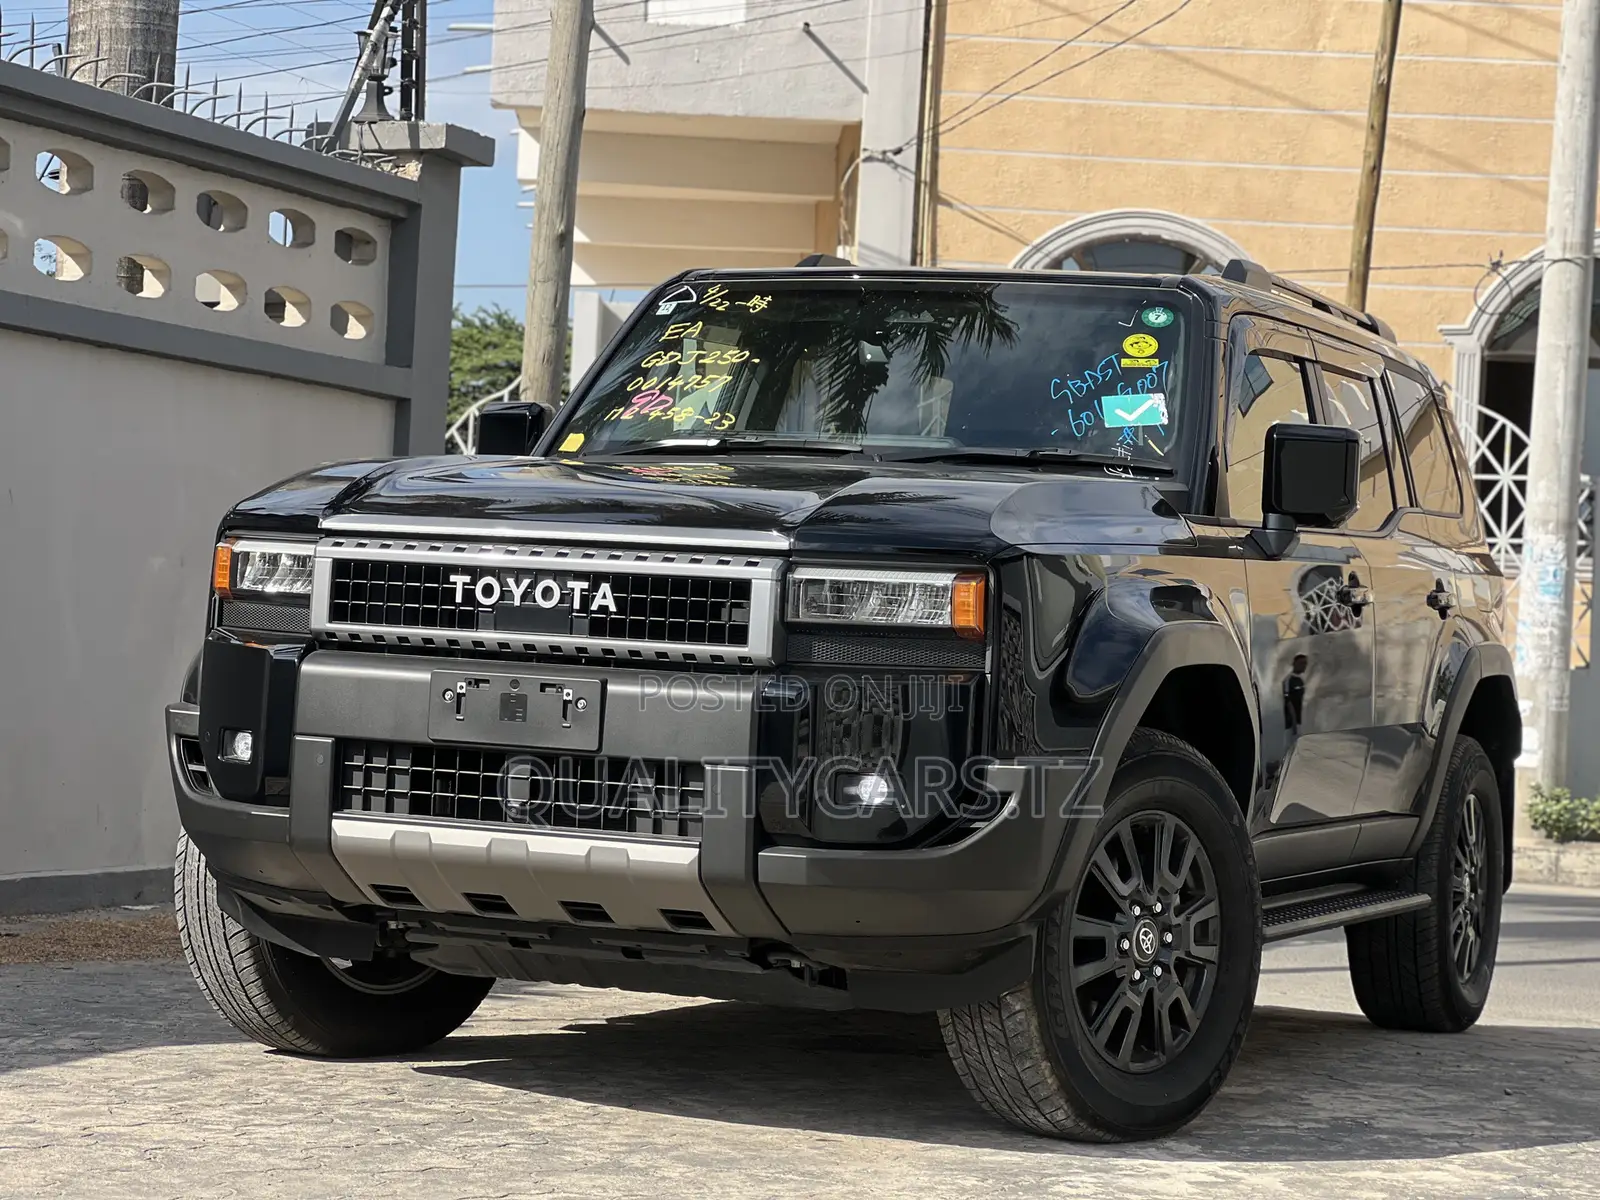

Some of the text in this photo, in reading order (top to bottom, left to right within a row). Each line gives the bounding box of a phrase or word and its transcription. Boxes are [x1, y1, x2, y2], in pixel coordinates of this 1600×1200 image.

[659, 321, 703, 342] EA
[626, 375, 733, 393] 0014757
[450, 575, 617, 612] TOYOTA
